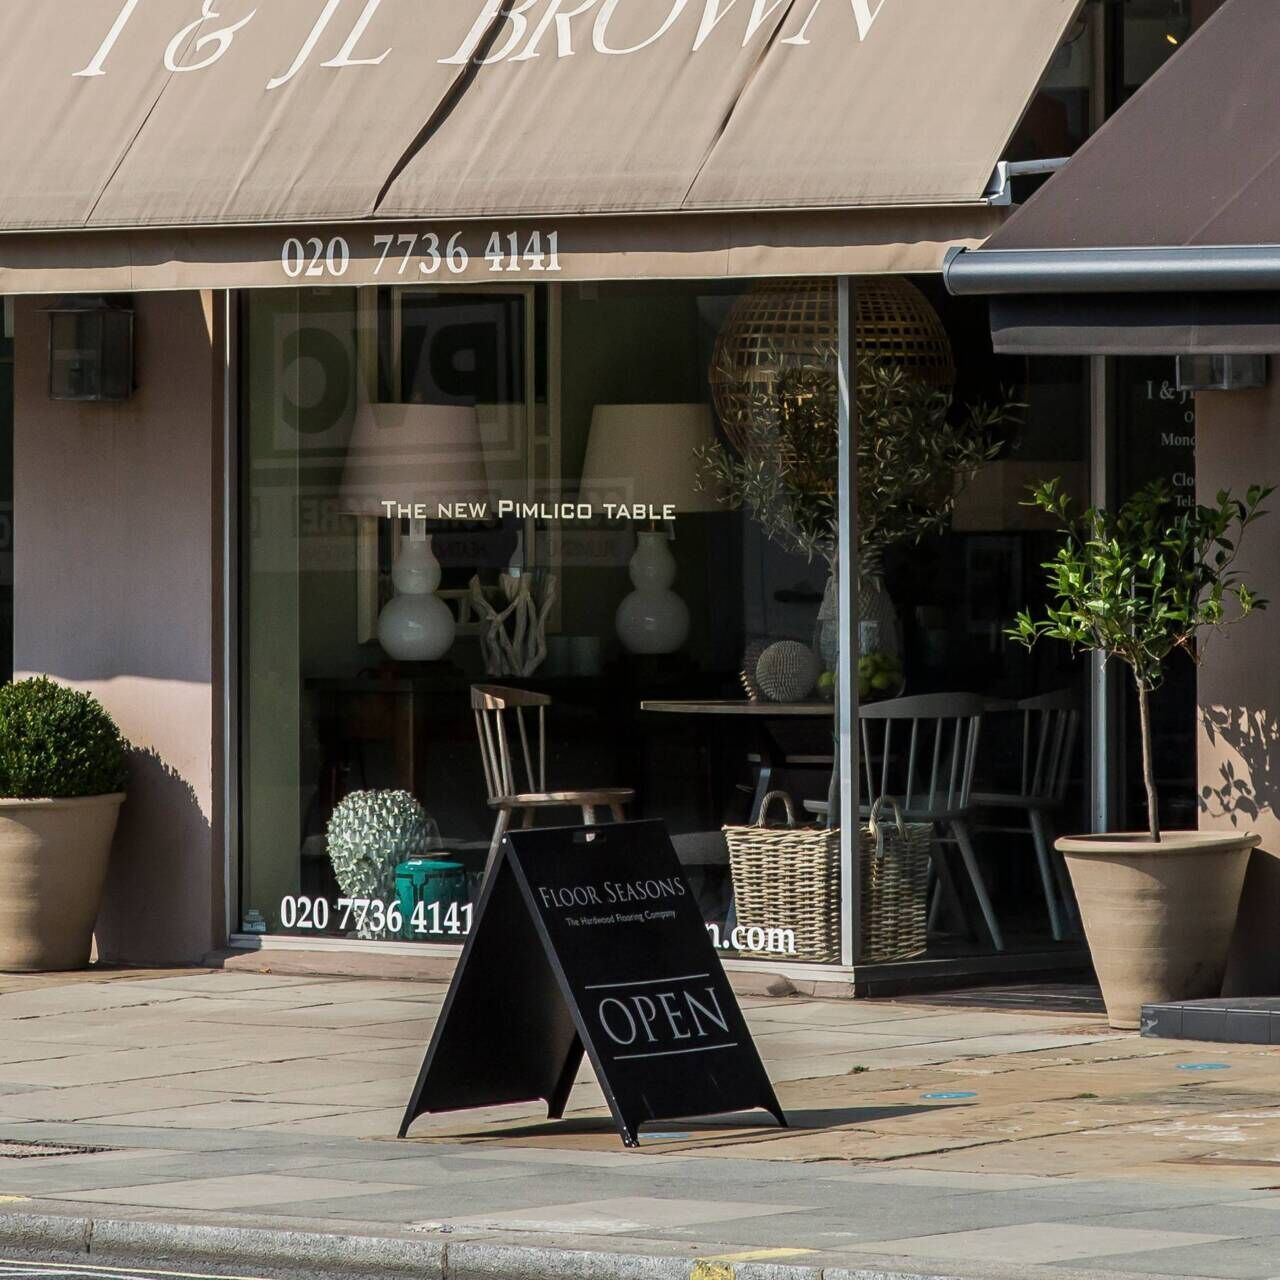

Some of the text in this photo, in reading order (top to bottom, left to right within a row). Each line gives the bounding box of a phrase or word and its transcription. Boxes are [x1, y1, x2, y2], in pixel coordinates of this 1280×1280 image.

[281, 230, 562, 278] 020 7736 4141
[381, 500, 426, 519] THE
[438, 502, 486, 518] NEW
[498, 500, 592, 519] PIMLICO
[603, 503, 676, 520] TABLE
[538, 876, 686, 909] FLOOR SEASONS
[280, 895, 329, 929] 020
[337, 898, 402, 933] 7736
[410, 900, 473, 935] 4141
[598, 986, 730, 1046] OPEN
